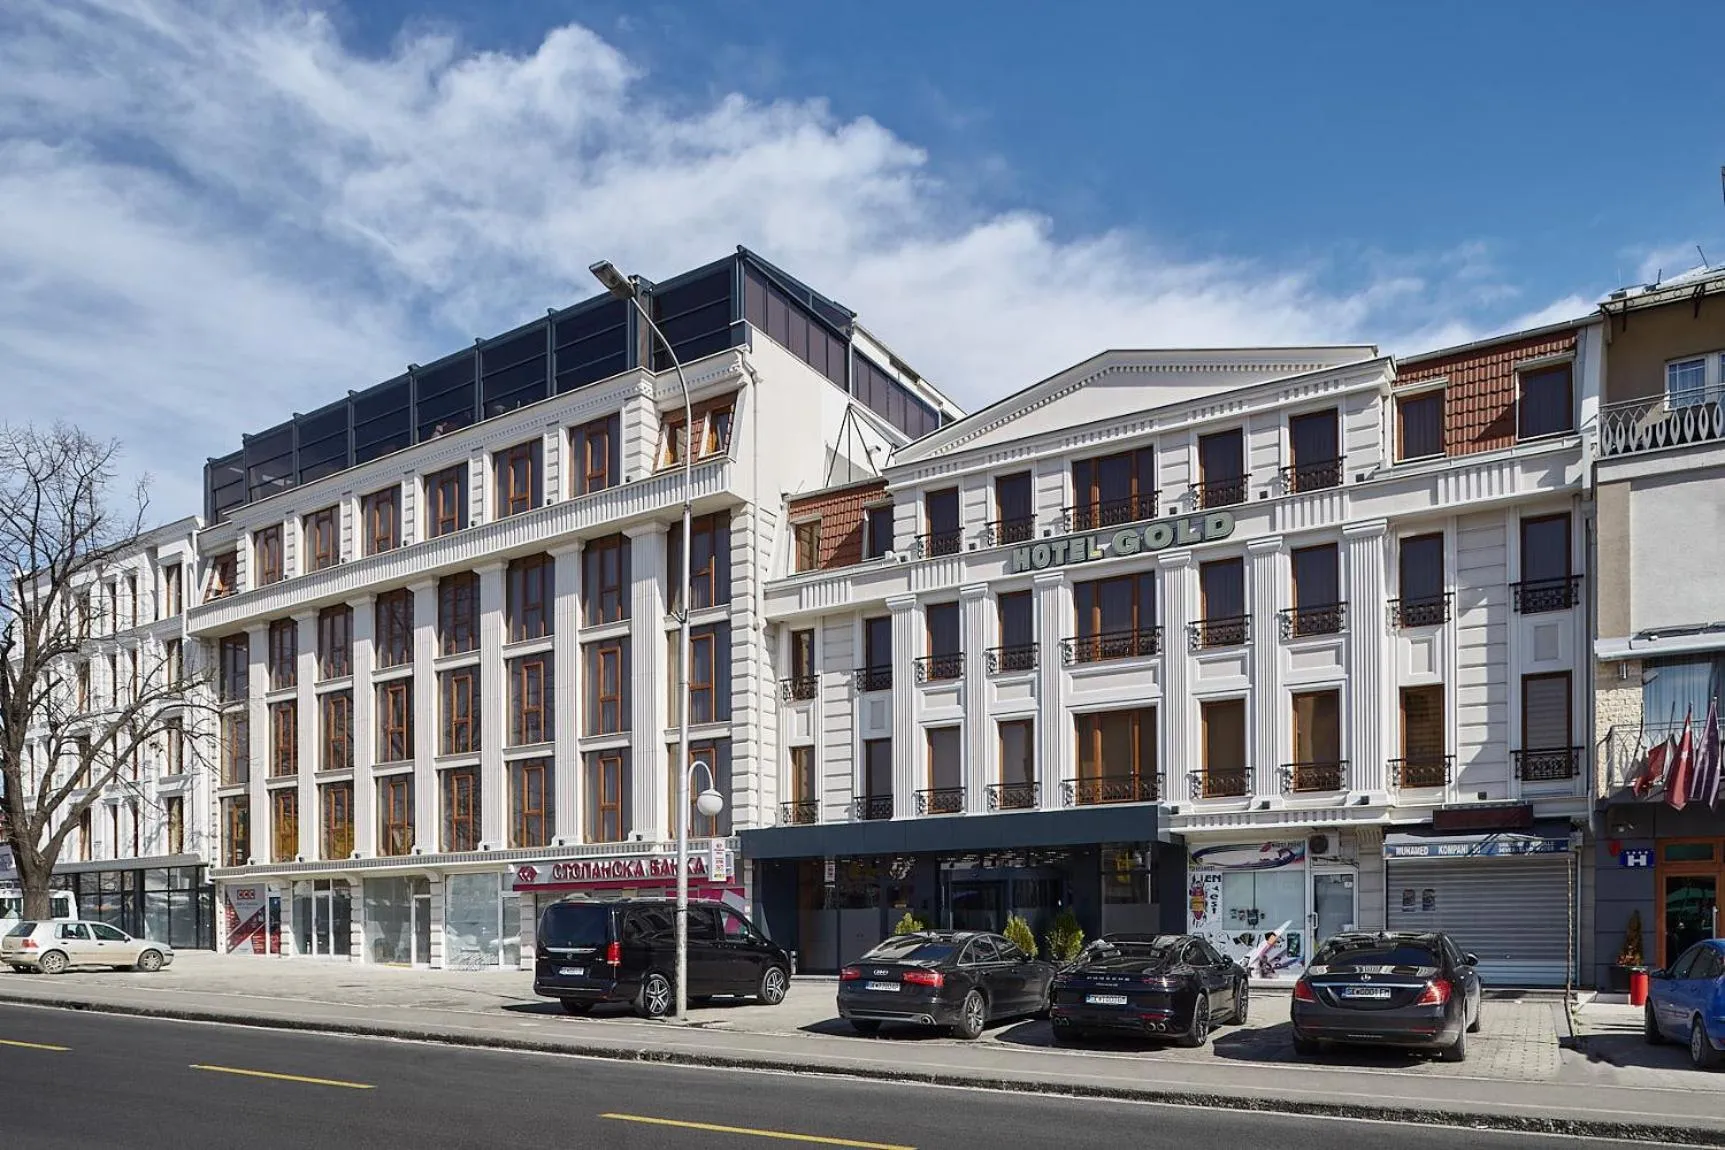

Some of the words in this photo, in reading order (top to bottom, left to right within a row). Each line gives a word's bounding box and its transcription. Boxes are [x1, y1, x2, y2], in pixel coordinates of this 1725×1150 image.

[1011, 536, 1104, 573] HOTEL
[1111, 511, 1236, 556] GOLD
[552, 859, 646, 880] СТОПАНСКА
